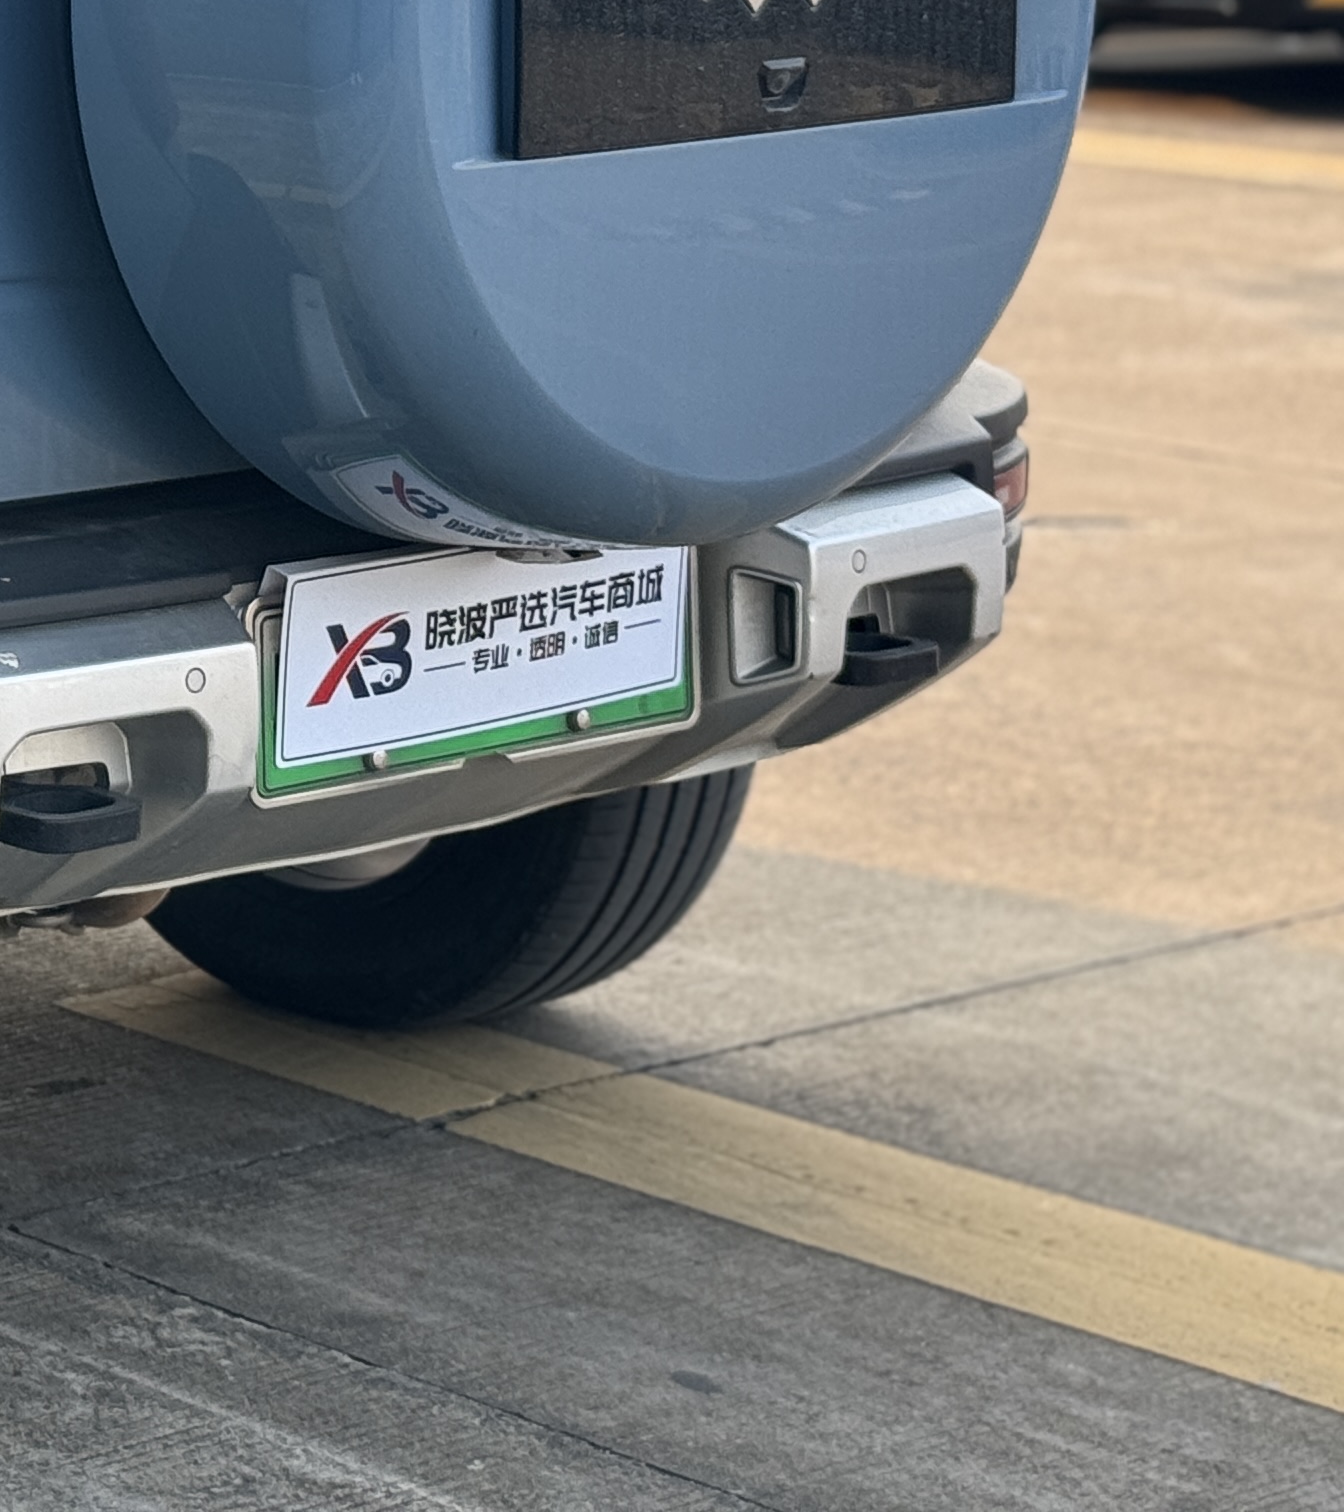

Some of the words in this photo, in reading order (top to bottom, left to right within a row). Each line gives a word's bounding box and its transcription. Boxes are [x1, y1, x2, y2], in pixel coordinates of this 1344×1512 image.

[424, 563, 665, 651] 晓波严选汽车商城
